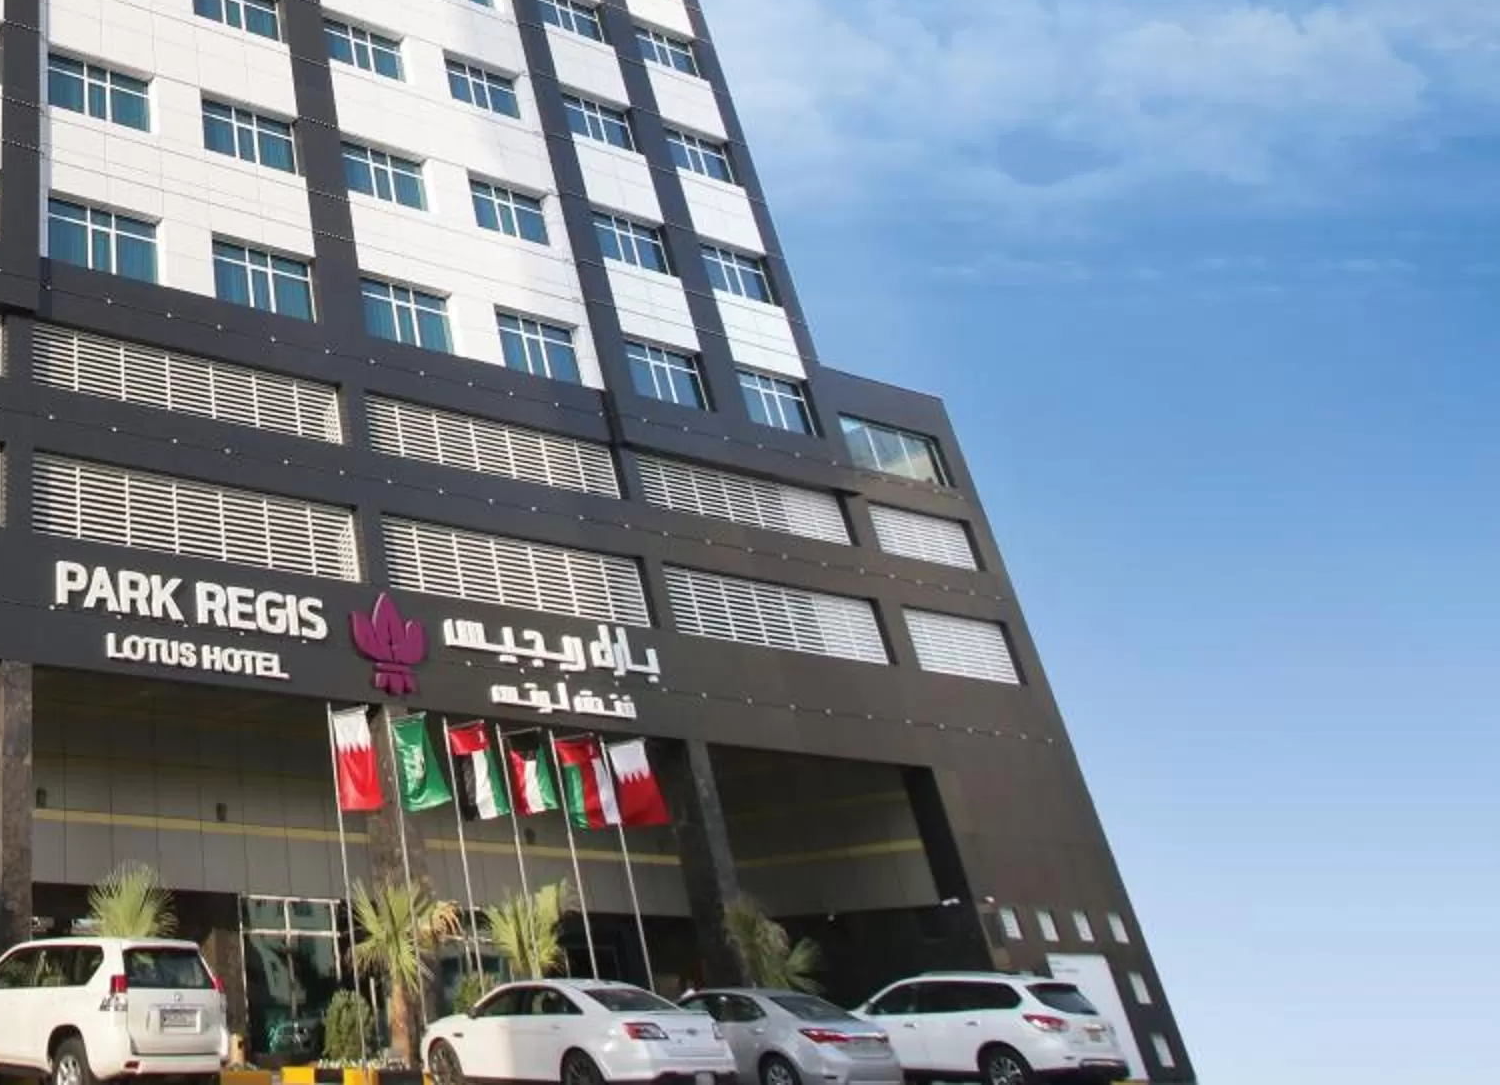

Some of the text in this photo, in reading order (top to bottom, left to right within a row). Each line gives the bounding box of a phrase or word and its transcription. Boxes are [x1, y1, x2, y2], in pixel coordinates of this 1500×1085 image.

[55, 560, 328, 640] PARK REGIS
[106, 633, 289, 679] LOTUS HOTEL
[443, 618, 661, 683] بارك ريجيس
[491, 682, 637, 719] فندق لوتس
